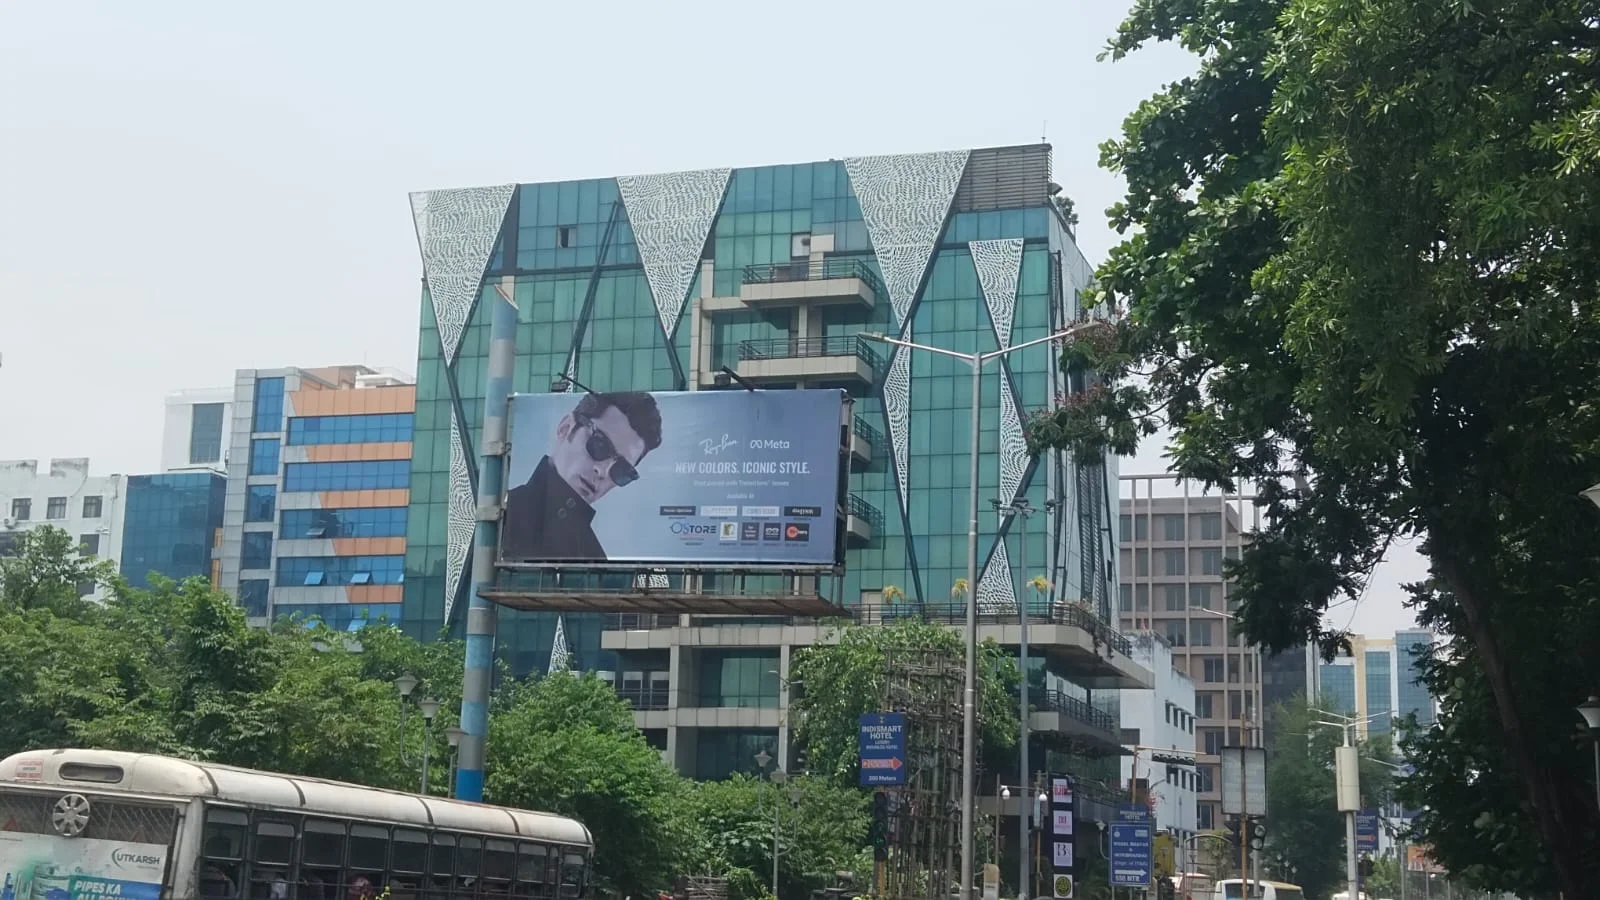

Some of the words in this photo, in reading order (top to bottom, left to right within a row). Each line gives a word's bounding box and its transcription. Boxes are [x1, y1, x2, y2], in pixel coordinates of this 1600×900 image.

[764, 439, 790, 449] Meta
[675, 462, 696, 474] NEW
[699, 462, 740, 474] COLORS.
[743, 462, 777, 474] ICONIC
[779, 462, 811, 474] STYLE.
[862, 725, 902, 733] INDISMART
[870, 732, 893, 740] HOTEL
[116, 853, 160, 865] UTKARSH
[74, 880, 105, 893] PIPES
[106, 882, 121, 896] KA
